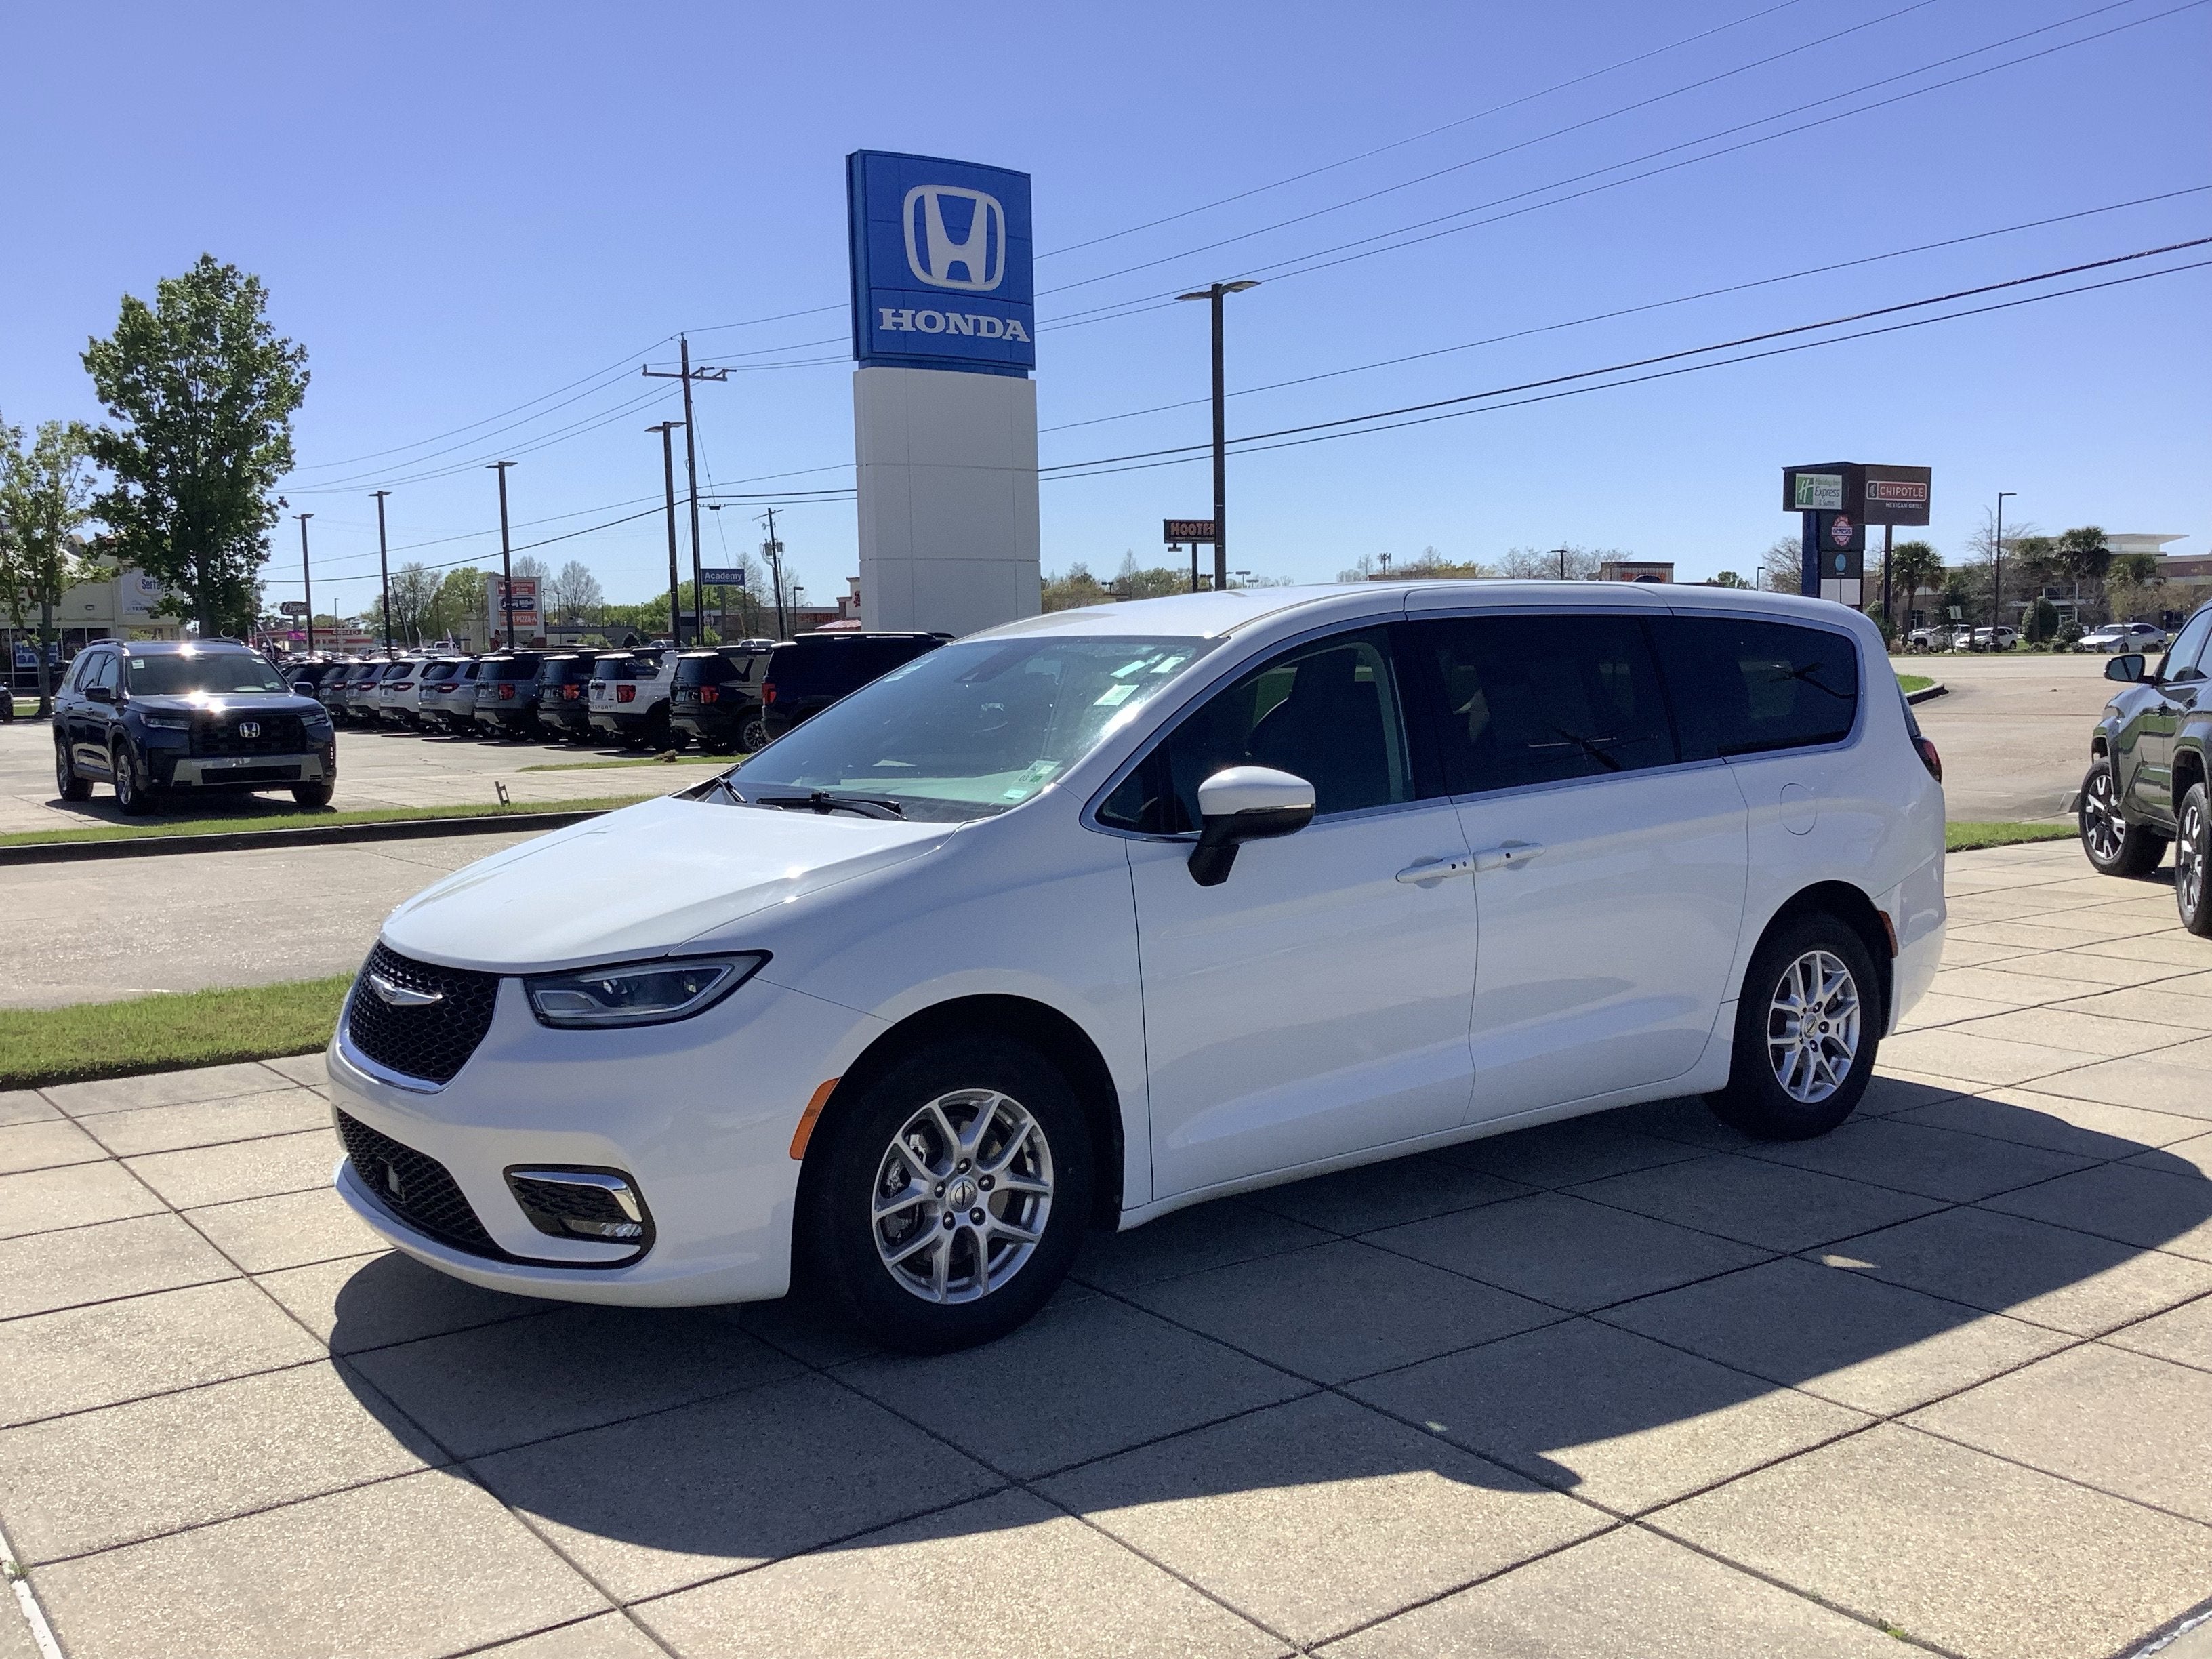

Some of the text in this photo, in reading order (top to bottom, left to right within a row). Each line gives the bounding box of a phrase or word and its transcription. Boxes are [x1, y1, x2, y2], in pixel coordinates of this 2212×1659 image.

[878, 308, 1031, 342] HONDA
[1814, 486, 1841, 499] Express
[1879, 487, 1924, 497] CHIPOTLE
[705, 572, 742, 581] Academy
